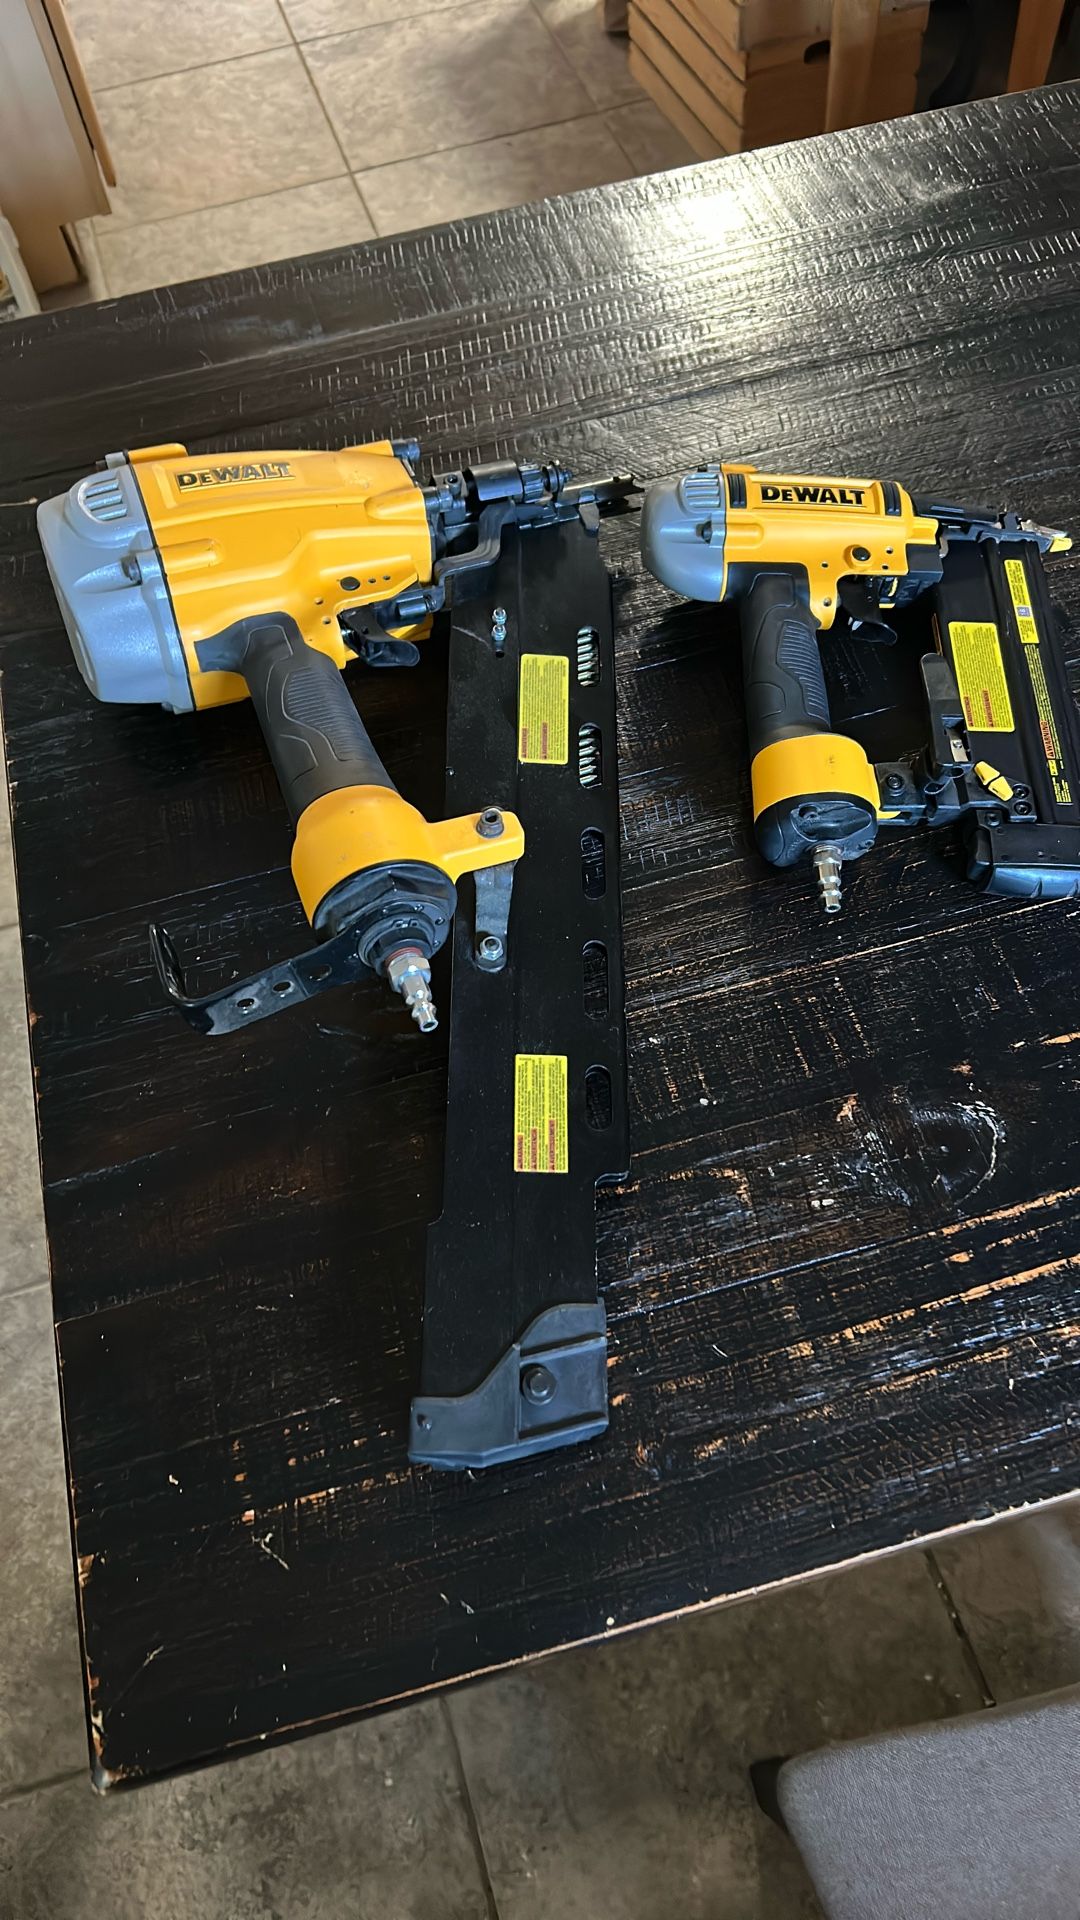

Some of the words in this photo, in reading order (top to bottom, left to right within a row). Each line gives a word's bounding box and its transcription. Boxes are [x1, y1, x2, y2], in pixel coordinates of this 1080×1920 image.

[177, 462, 291, 487] DEWALT
[761, 485, 865, 505] DEWALT
[1040, 720, 1053, 752] WARNING
